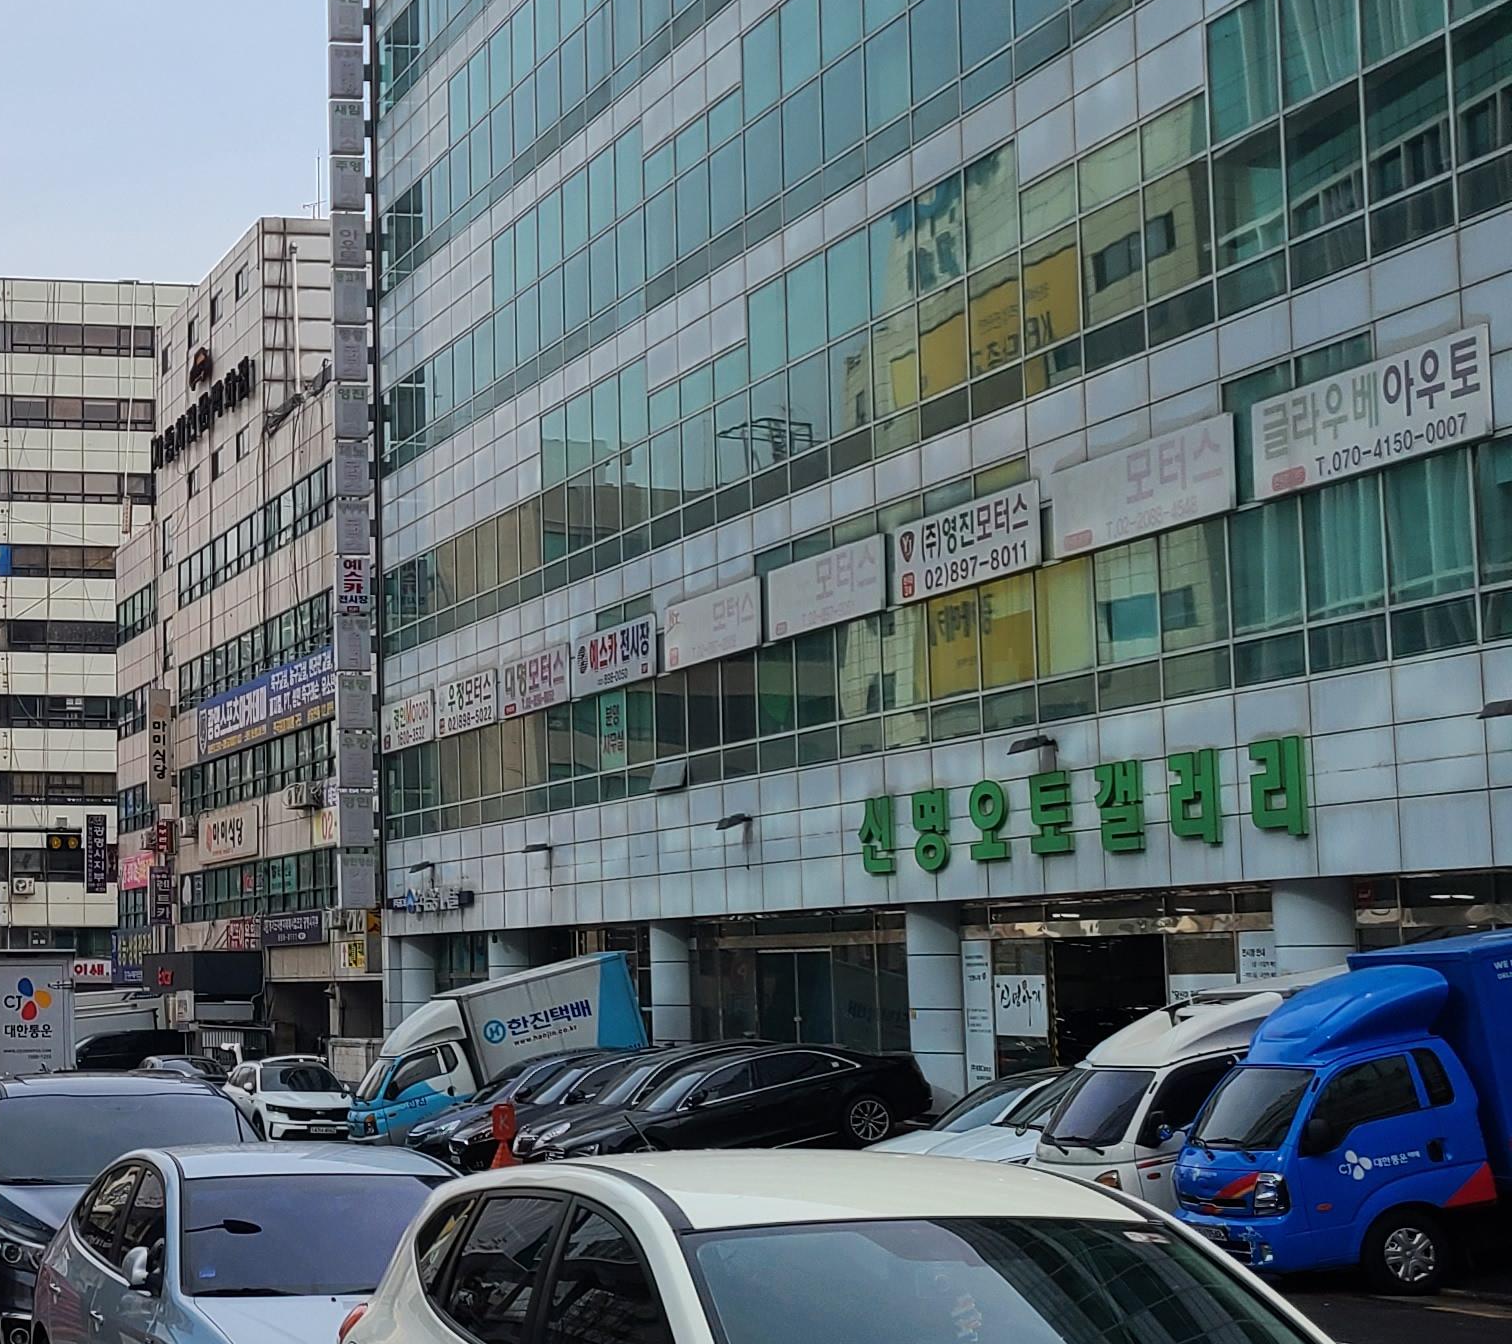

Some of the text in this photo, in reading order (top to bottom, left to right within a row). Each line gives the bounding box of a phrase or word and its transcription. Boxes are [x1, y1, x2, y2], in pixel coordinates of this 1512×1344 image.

[1314, 412, 1468, 476] T.070-4150-0007
[920, 493, 1029, 563] (주)영진모터스
[924, 540, 1028, 591] 02)897-8011
[620, 621, 650, 662] 전시장
[447, 673, 492, 713] 우정모터스
[152, 720, 168, 780] 마미식당
[857, 735, 1310, 875] 신명오토갤러리
[156, 879, 171, 919] 렌트카
[3, 995, 23, 1012] CJ
[506, 999, 593, 1037] 한진택배
[4, 1024, 53, 1038] 대한통운
[513, 1024, 578, 1047] www.hanjin.co.kr
[1338, 1164, 1352, 1176] CJ
